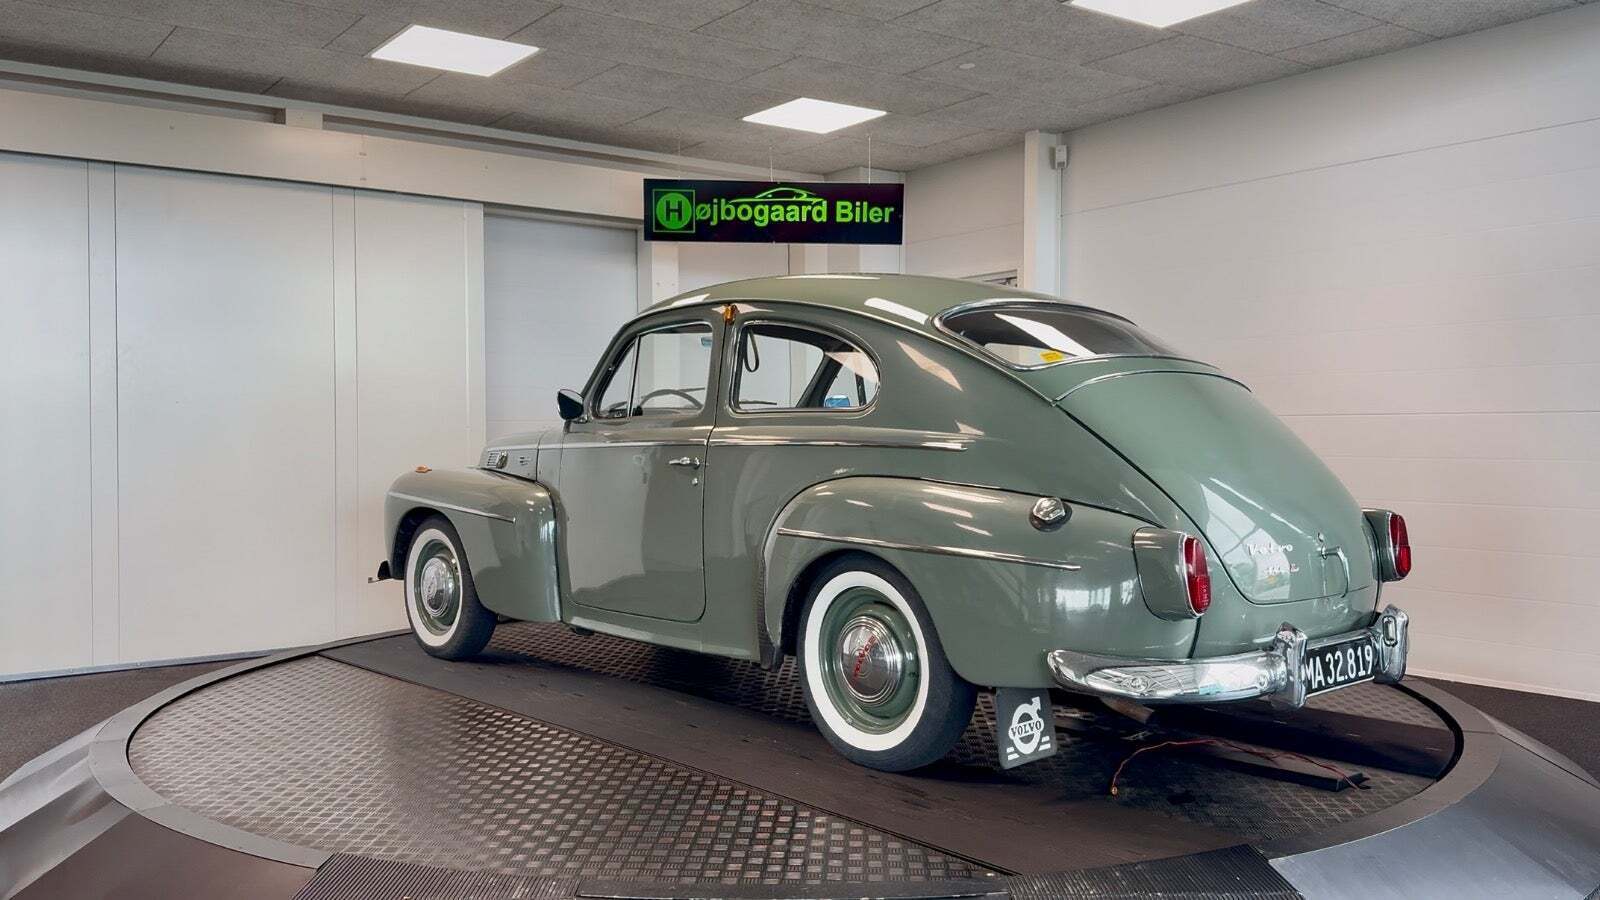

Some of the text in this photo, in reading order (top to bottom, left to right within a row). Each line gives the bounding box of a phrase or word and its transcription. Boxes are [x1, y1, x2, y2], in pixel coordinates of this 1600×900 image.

[835, 200, 895, 223] Biler
[1325, 644, 1373, 684] 32.819
[1010, 720, 1042, 737] VOLVO
